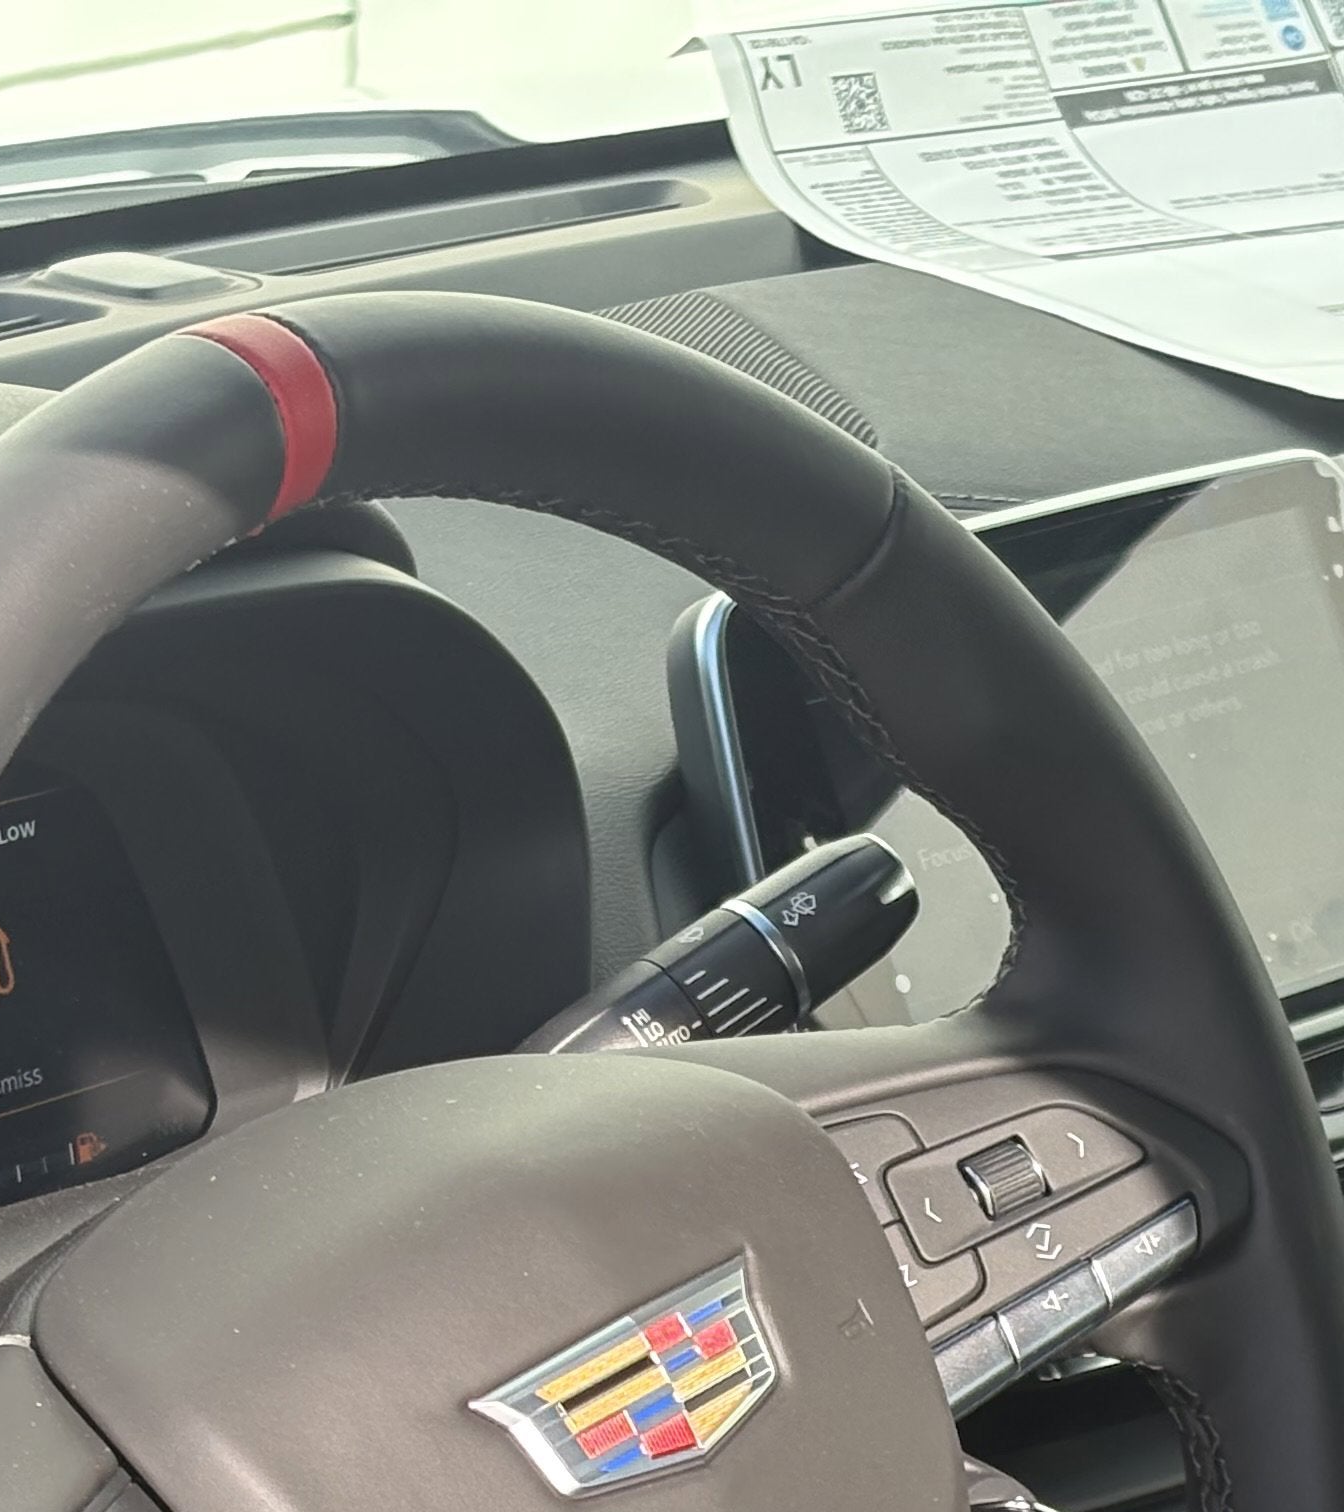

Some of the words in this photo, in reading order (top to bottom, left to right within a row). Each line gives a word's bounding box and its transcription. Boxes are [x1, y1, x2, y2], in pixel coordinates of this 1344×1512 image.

[760, 53, 803, 91] LY
[631, 1008, 652, 1028] HI
[643, 1021, 665, 1042] LO
